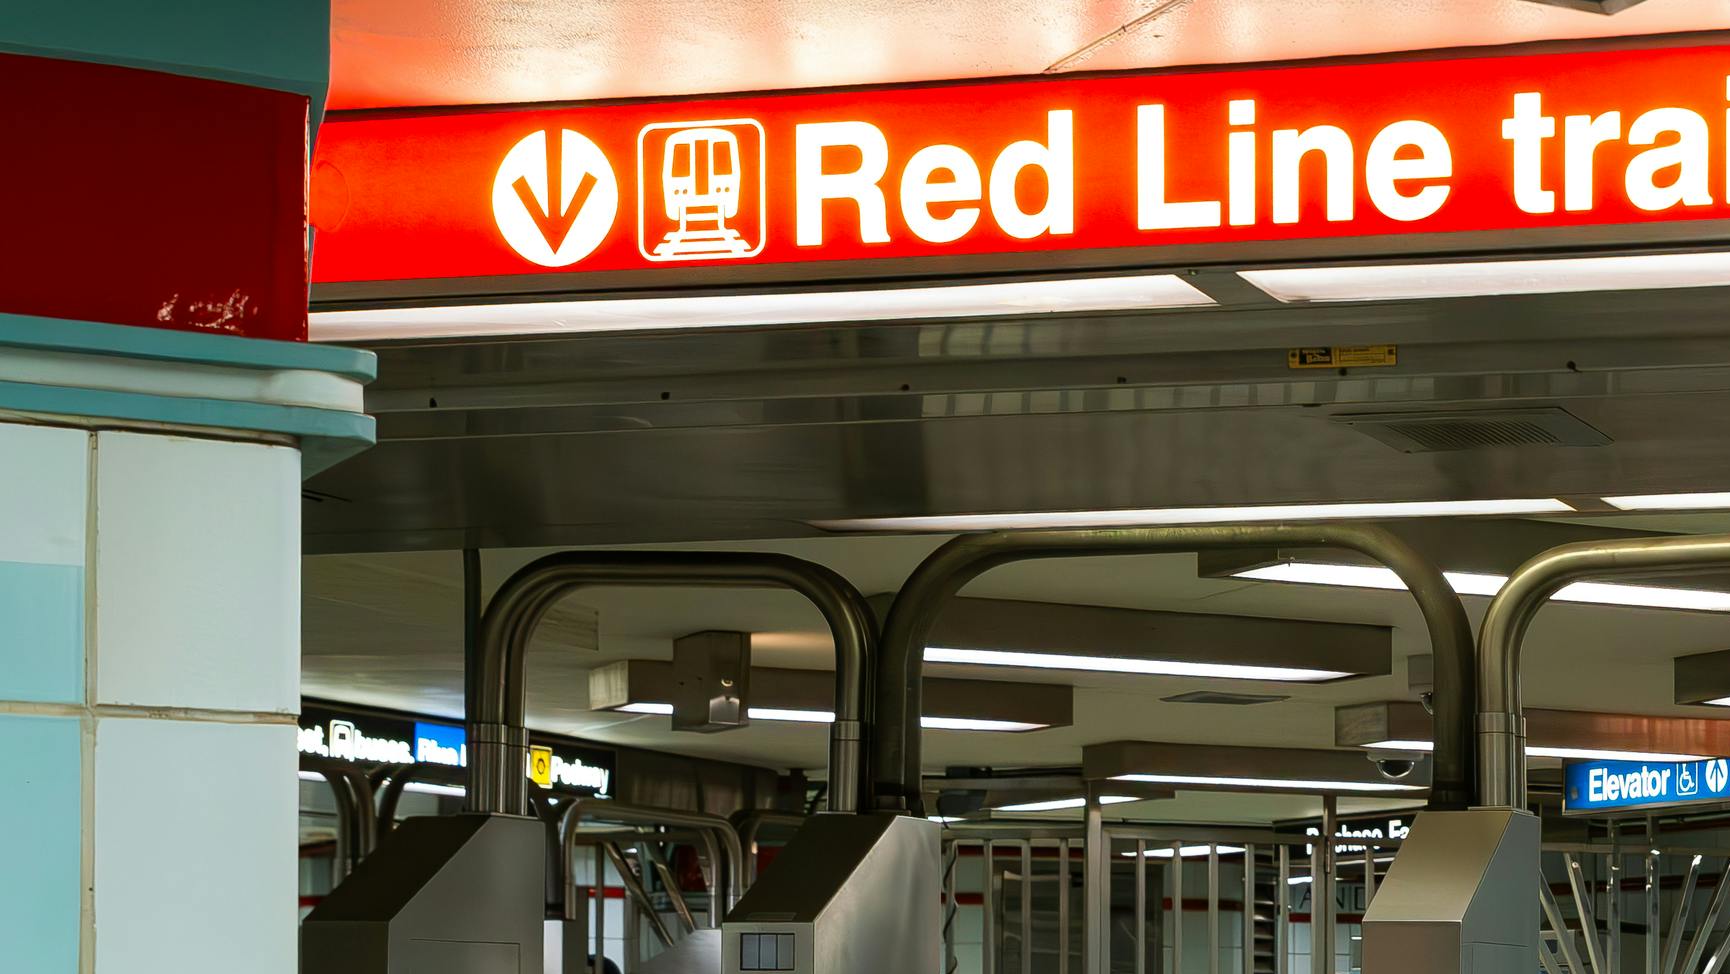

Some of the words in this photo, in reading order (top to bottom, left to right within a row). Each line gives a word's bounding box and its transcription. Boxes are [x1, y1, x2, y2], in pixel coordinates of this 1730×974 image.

[795, 108, 1075, 248] Red
[1135, 99, 1453, 231] Line
[1589, 765, 1671, 802] Elevator
